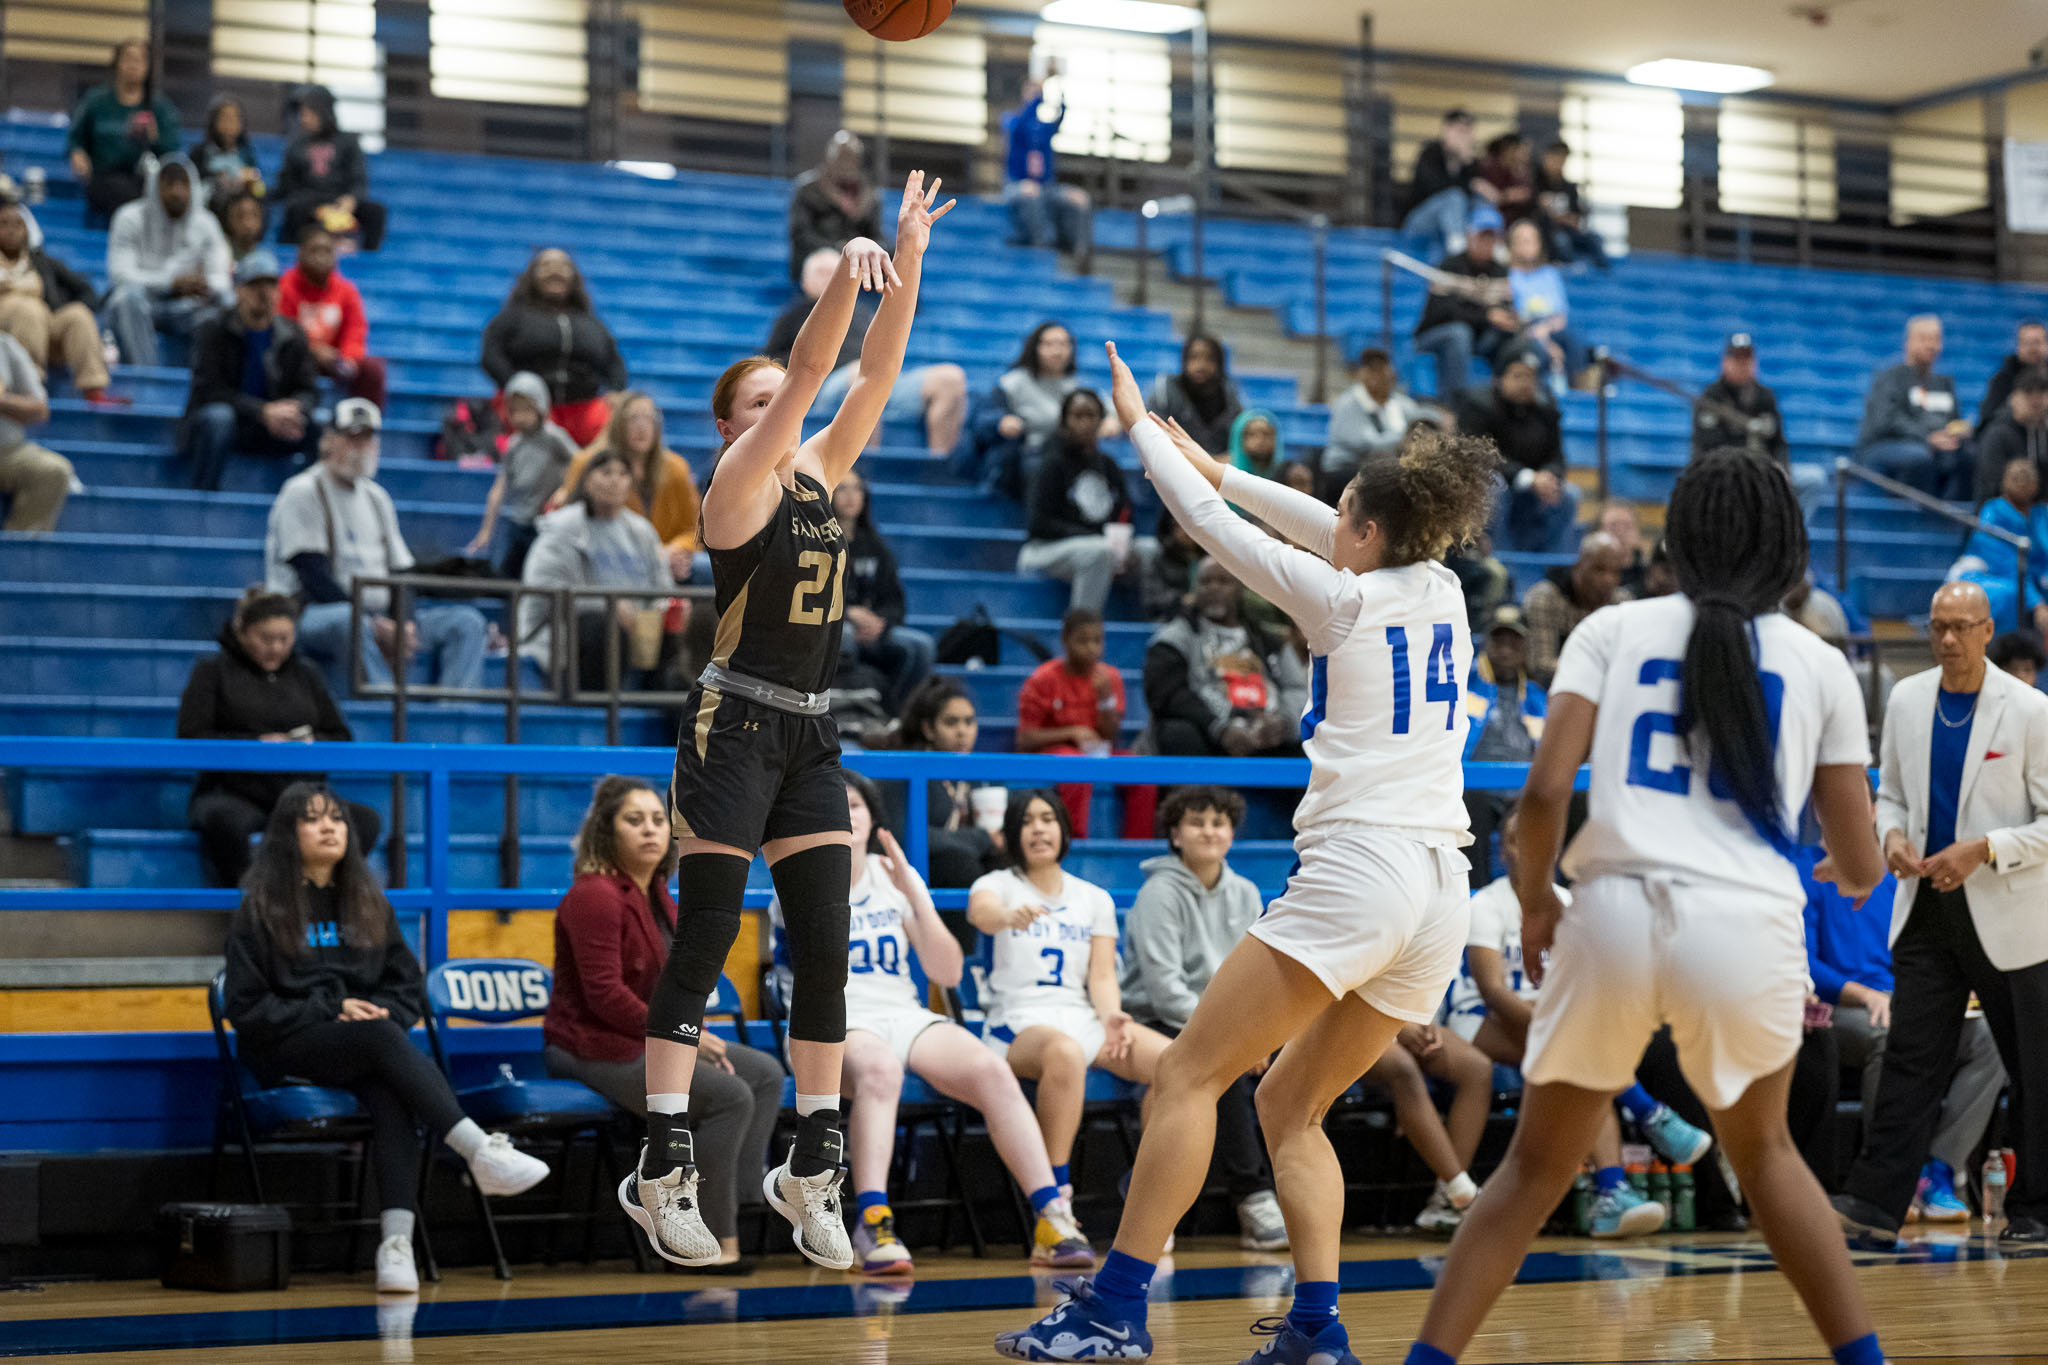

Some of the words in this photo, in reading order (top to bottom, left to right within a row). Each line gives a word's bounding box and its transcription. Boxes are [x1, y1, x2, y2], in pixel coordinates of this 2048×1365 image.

[1386, 624, 1458, 734] 14
[1036, 947, 1063, 987] 3
[443, 969, 550, 1011] DONS
